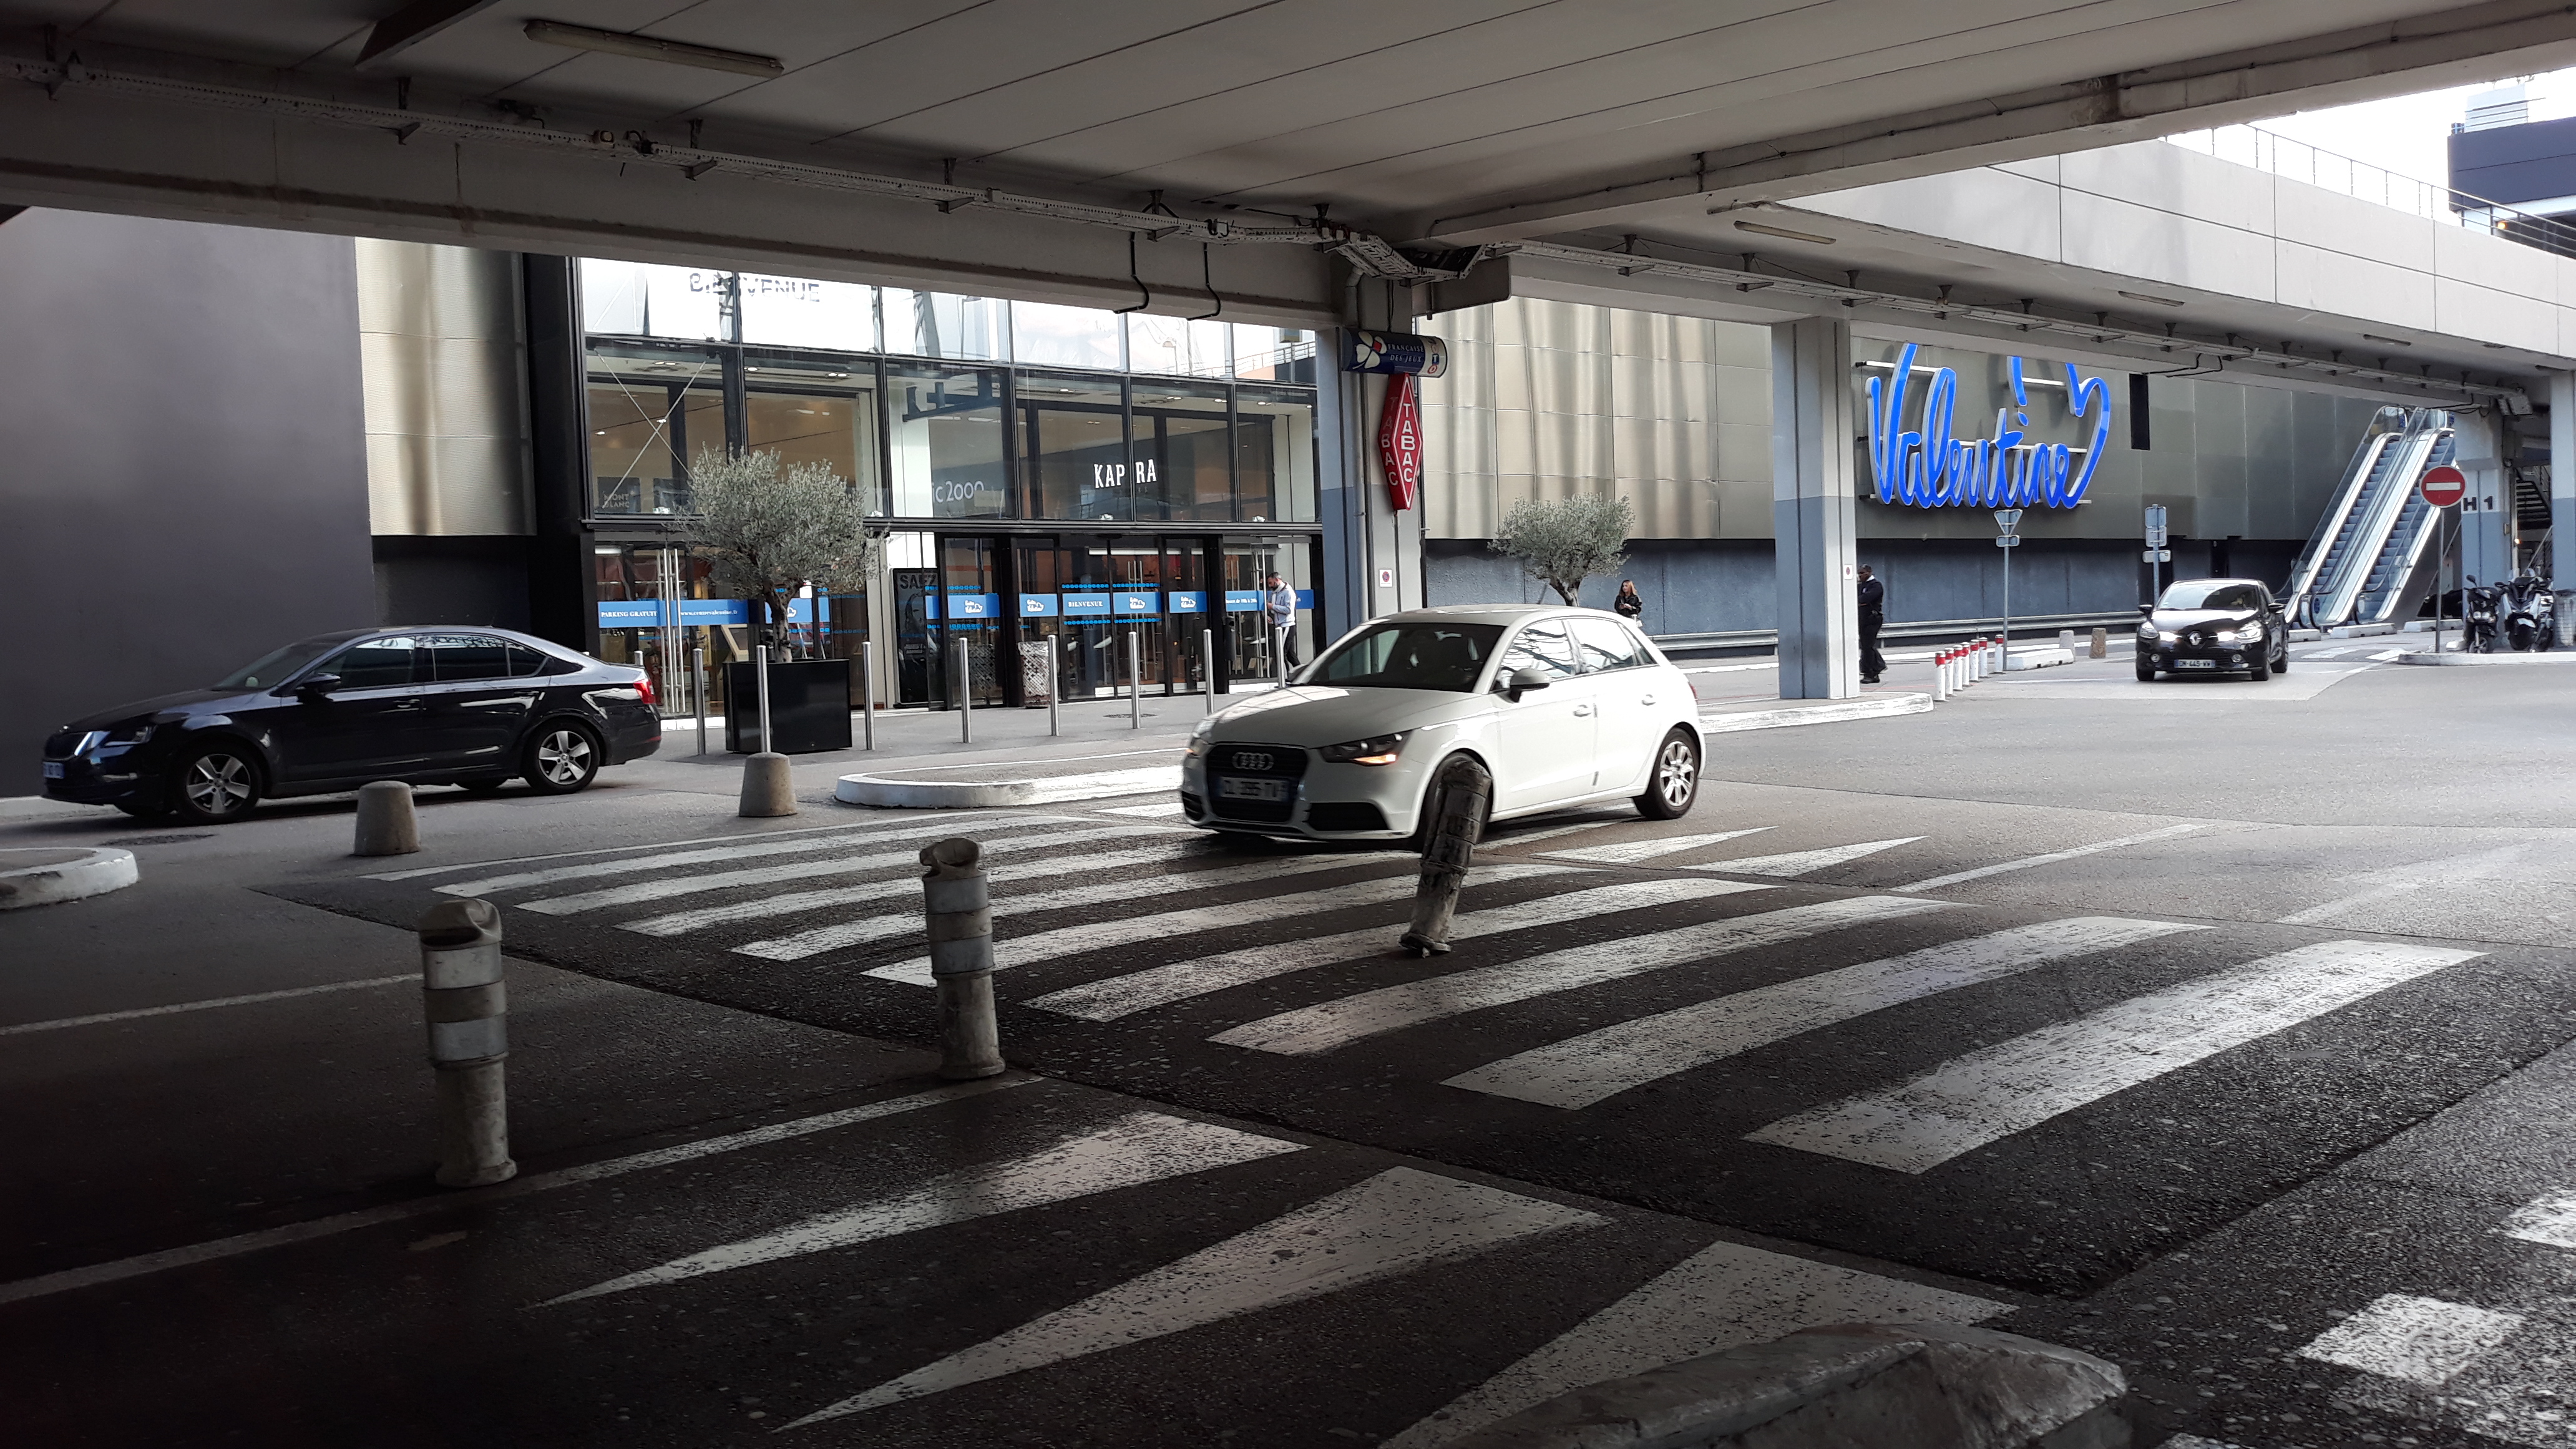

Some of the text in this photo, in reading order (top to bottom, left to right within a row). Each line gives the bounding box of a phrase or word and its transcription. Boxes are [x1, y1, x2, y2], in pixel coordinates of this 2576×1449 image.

[1404, 354, 1422, 363] JEUX
[1381, 396, 1398, 486] TABAC
[1865, 343, 2111, 509] Valentine
[1401, 403, 1415, 482] TABAC
[1093, 459, 1157, 489] KAPRA
[945, 481, 985, 502] 2000
[2462, 495, 2494, 512] H 1
